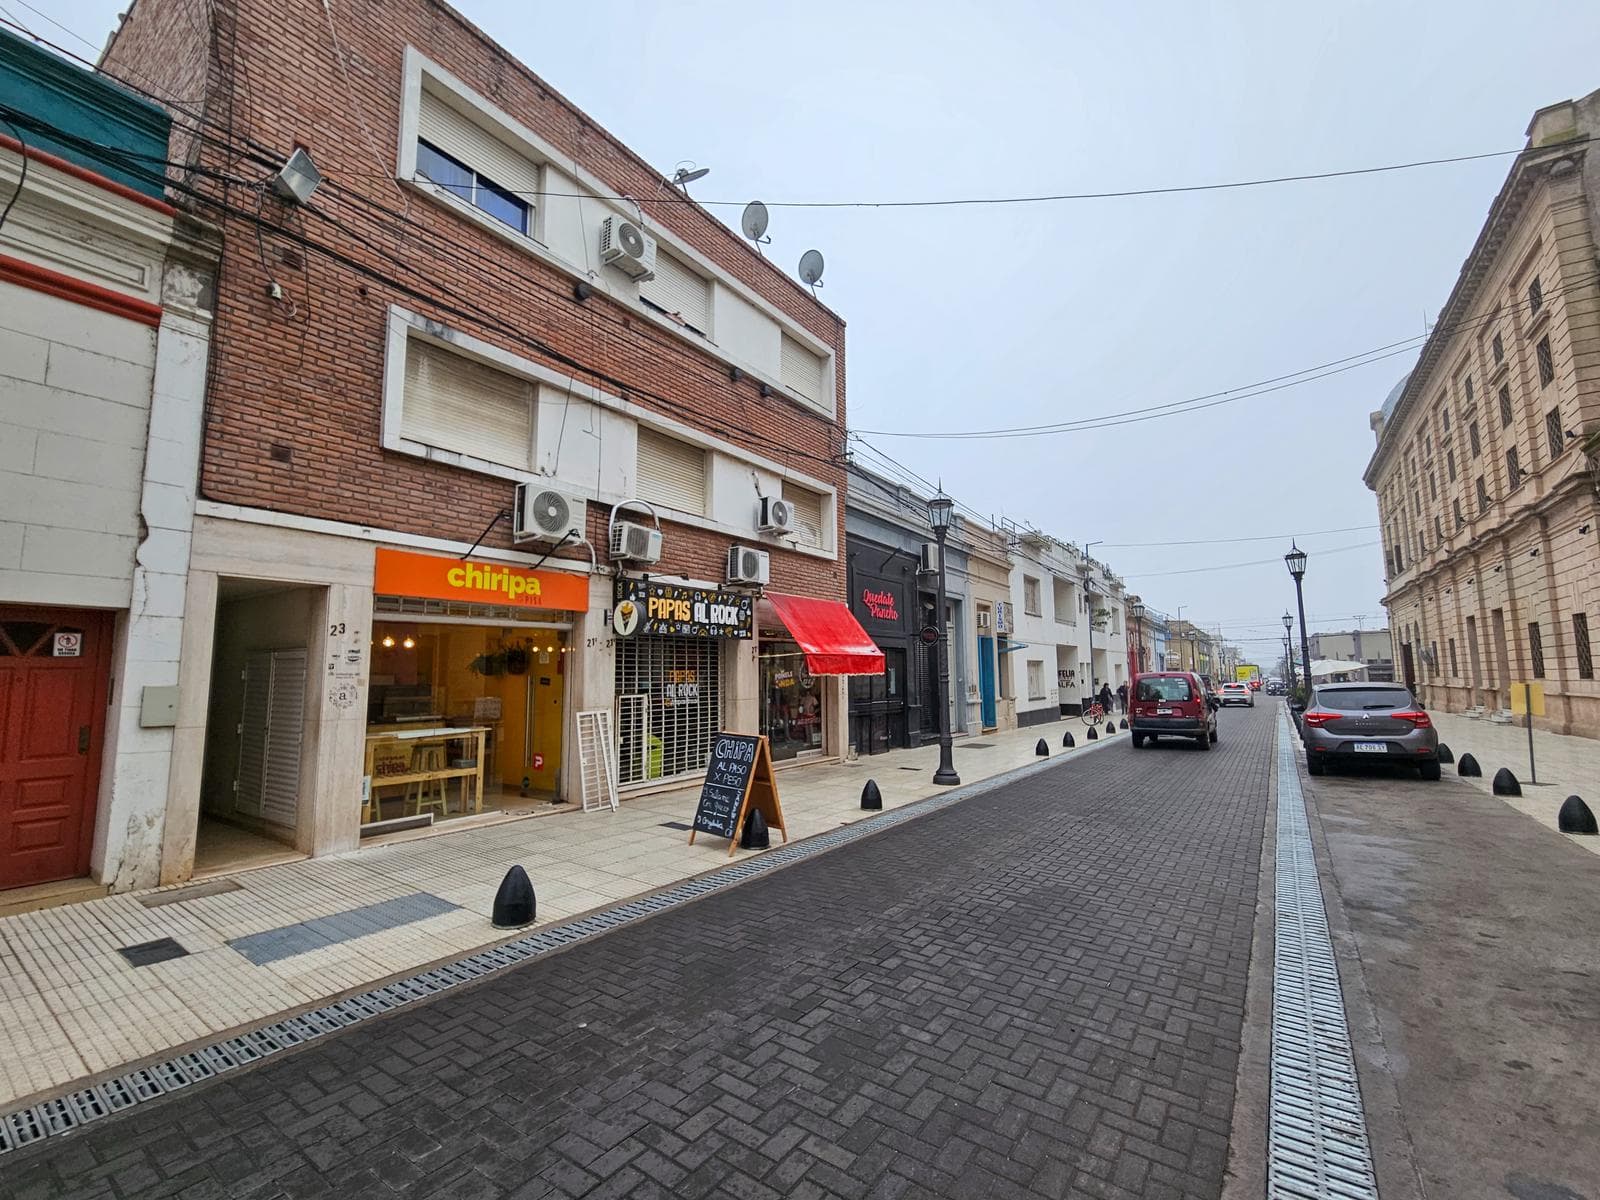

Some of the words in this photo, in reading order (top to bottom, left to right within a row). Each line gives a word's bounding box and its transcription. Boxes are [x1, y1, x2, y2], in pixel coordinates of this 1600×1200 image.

[447, 563, 541, 600] chiripa
[863, 588, 894, 606] Quedate
[648, 597, 691, 622] PAPAS
[694, 602, 709, 624] AL
[710, 604, 739, 626] ROCK
[871, 603, 899, 620] Pancho
[330, 622, 346, 637] 23
[716, 761, 727, 771] AL
[728, 763, 747, 775] PASO
[723, 773, 742, 787] PESO
